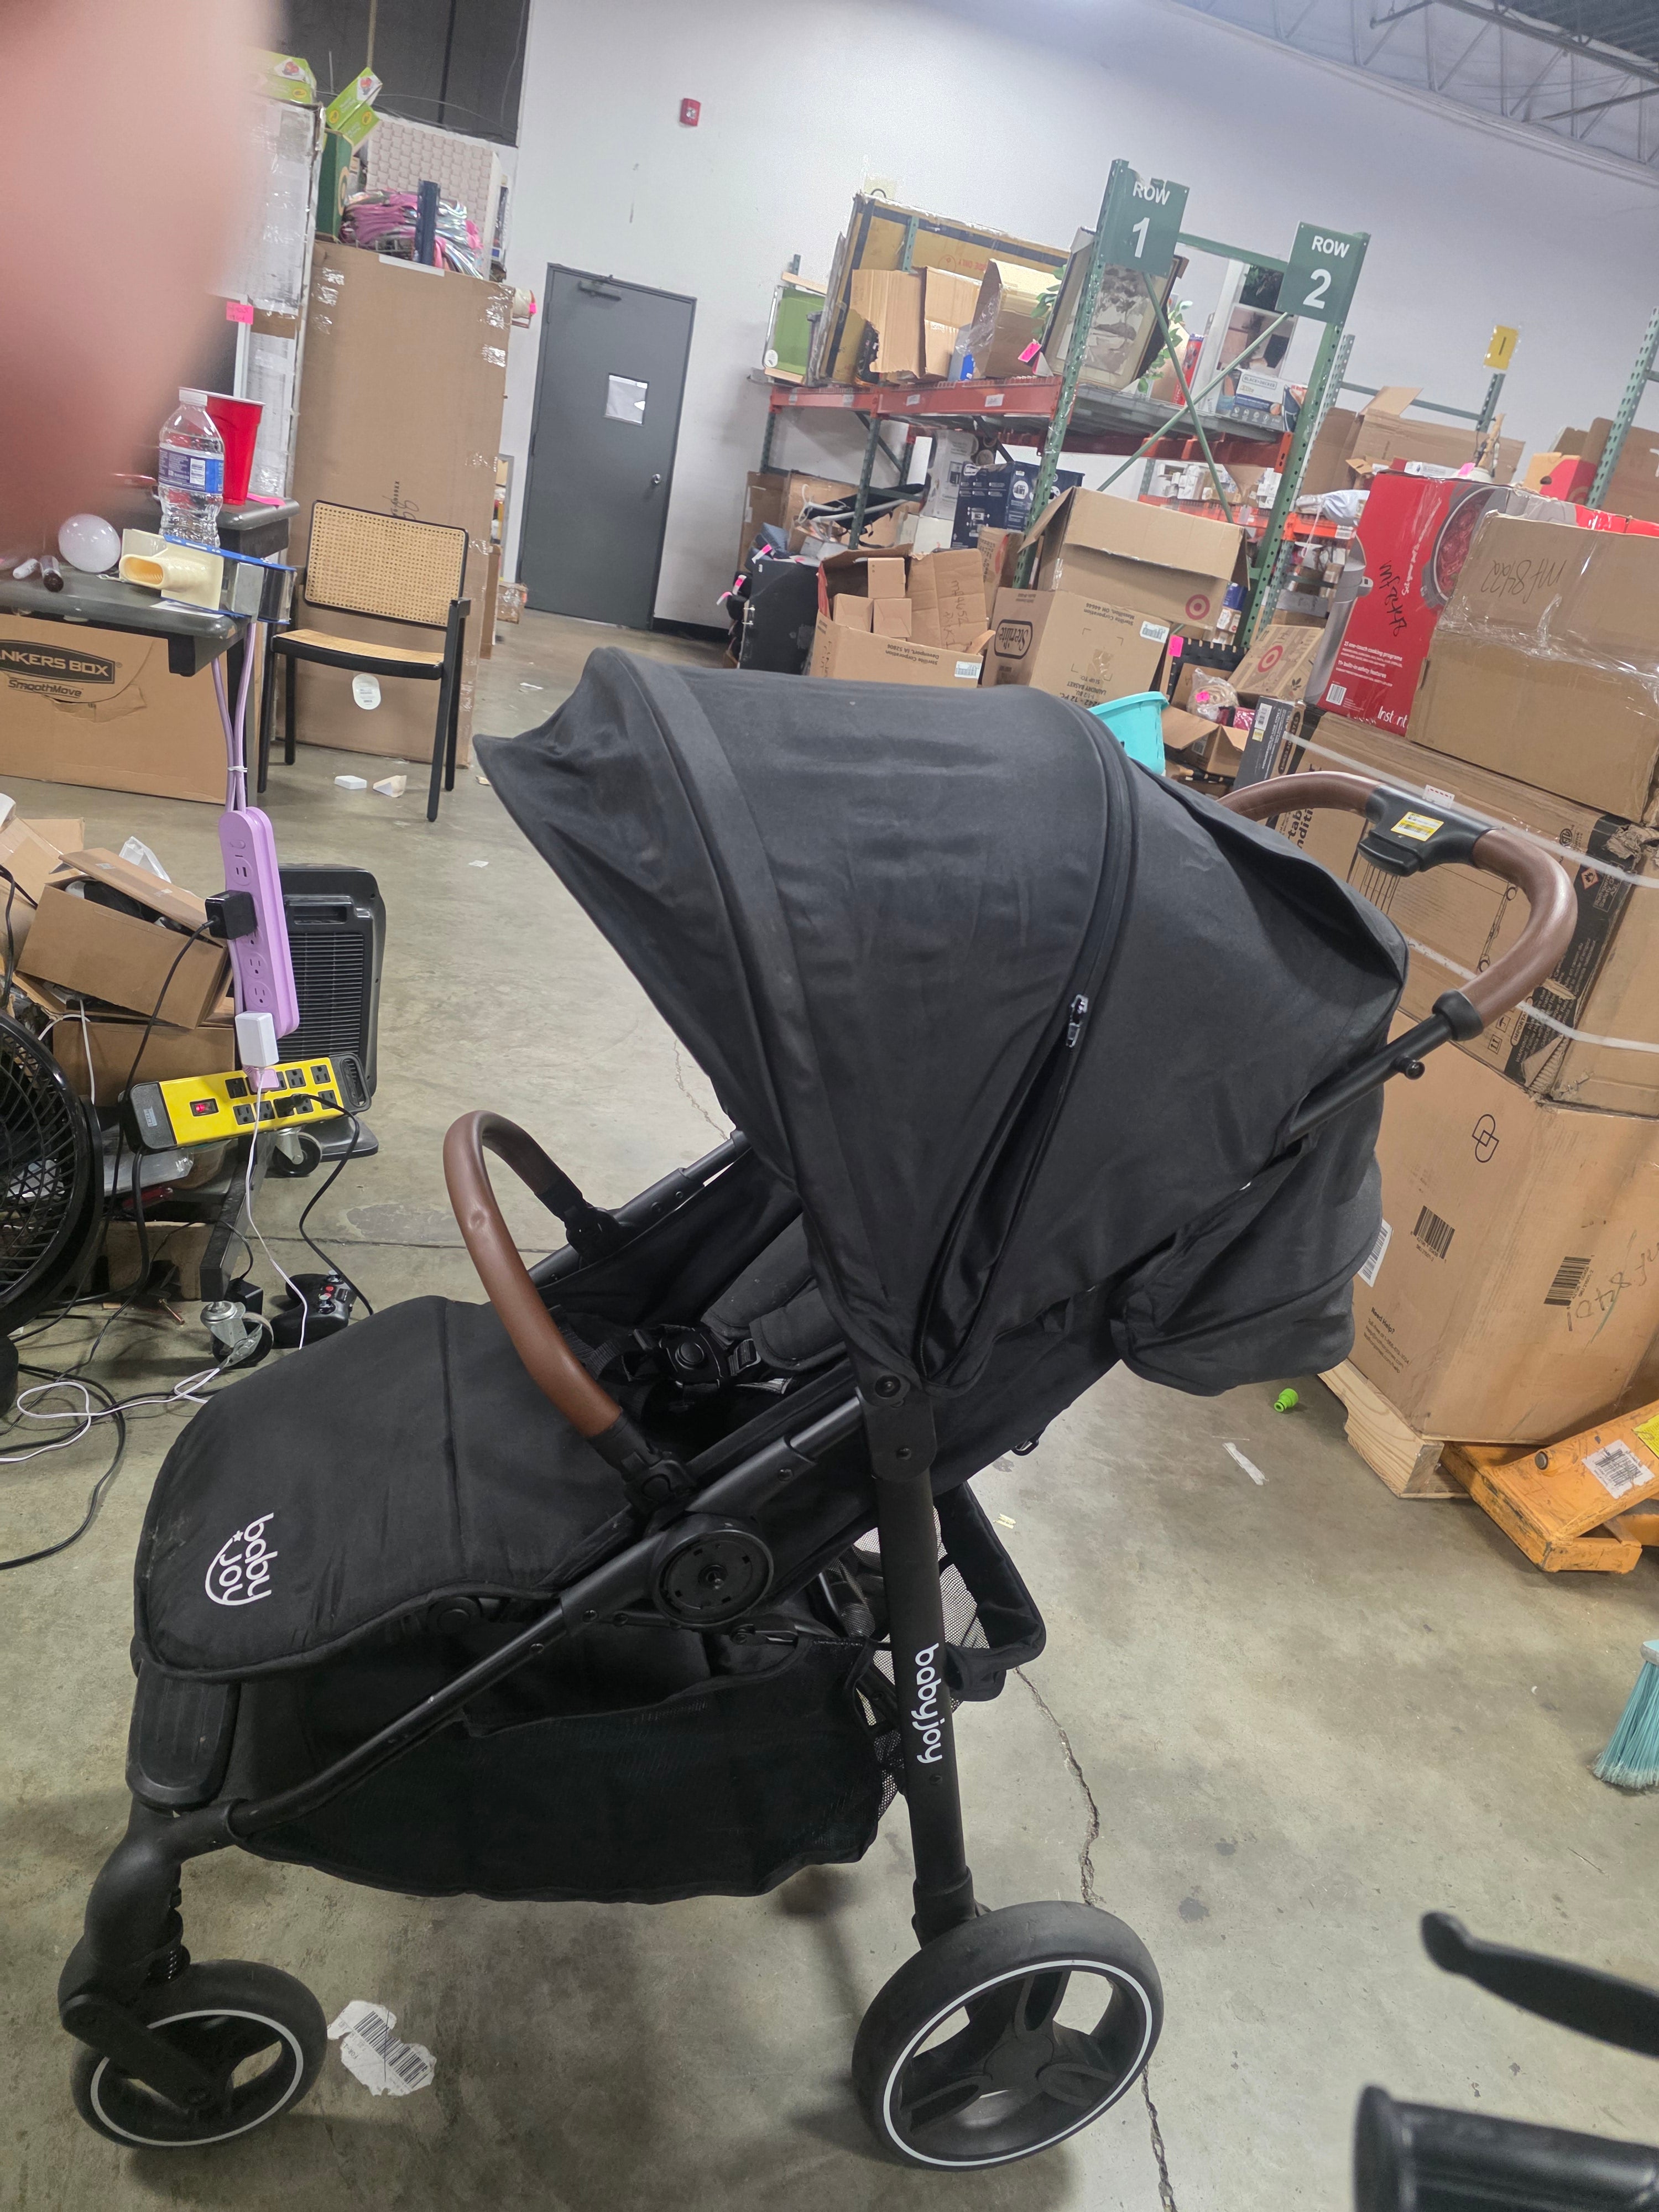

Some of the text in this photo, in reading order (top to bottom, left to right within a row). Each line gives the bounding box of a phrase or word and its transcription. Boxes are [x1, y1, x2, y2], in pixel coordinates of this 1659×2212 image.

[1133, 181, 1170, 205] ROW
[1133, 217, 1150, 258] 1
[1312, 236, 1349, 258] ROW
[1303, 269, 1331, 309] 2
[1083, 607, 1134, 626] Sterilite Corporation
[1110, 608, 1135, 619] Massillon,
[998, 623, 1031, 650] Sterilite
[884, 649, 938, 666] Sterilite Corporation
[910, 648, 939, 660] Davenport,
[69, 659, 110, 677] BOX
[8, 678, 82, 697] SmoothMove
[1066, 680, 1107, 696] LAUNDRY BASKET
[1376, 705, 1408, 727] Instant
[1609, 881, 1619, 896] A2L
[1370, 1306, 1396, 1335] Need Help?
[911, 1643, 945, 1764] babyjoy
